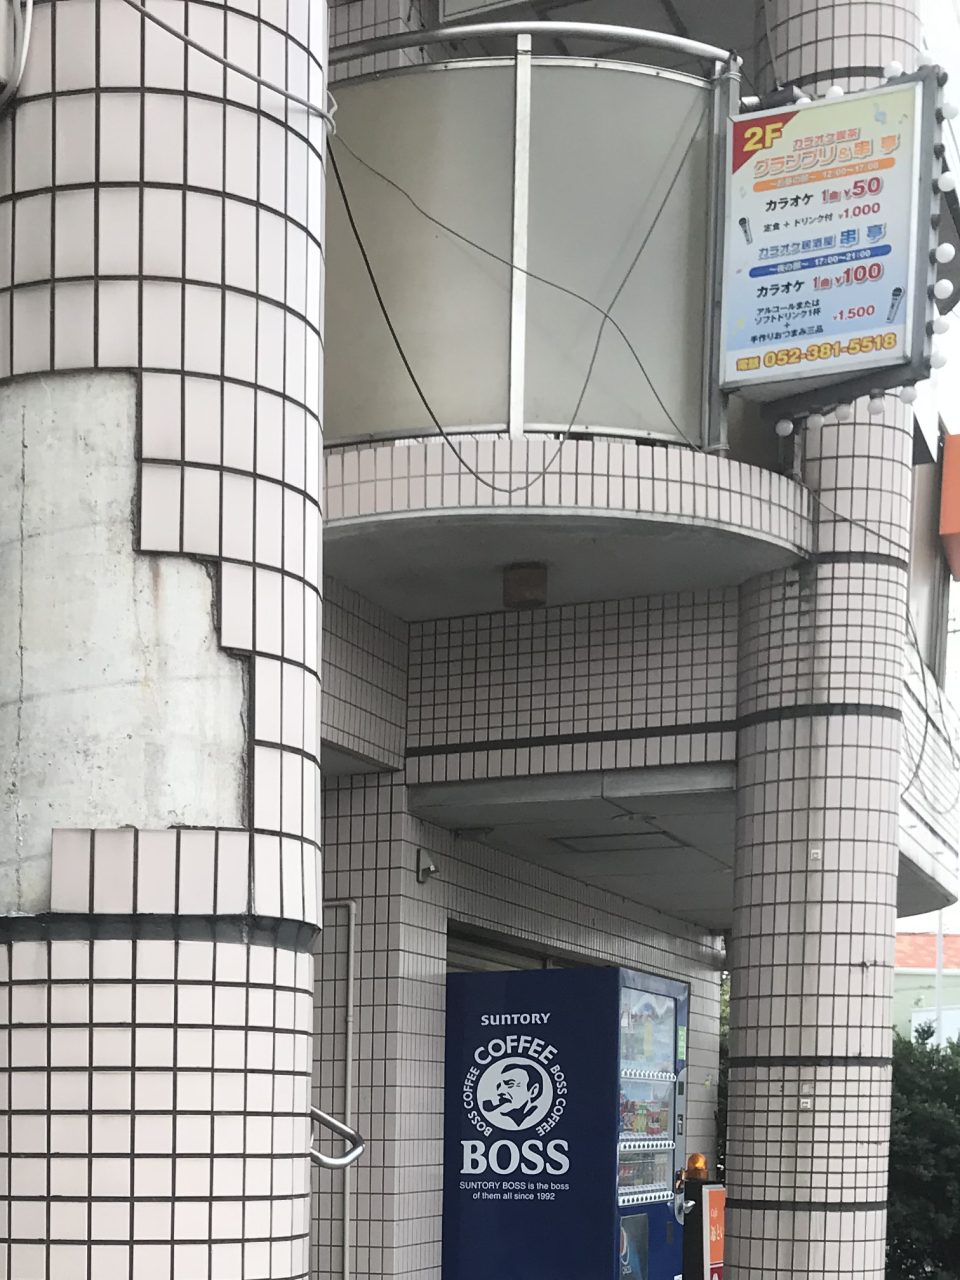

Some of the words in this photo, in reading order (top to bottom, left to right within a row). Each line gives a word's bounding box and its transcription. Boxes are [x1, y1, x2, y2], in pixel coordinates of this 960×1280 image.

[743, 122, 784, 152] 2F
[765, 193, 814, 212] カラオケ
[756, 280, 805, 298] カラオケ
[754, 308, 822, 325] ソフトドリンク1杯
[756, 299, 820, 315] アルコールまたは
[750, 325, 824, 344] 手作りおつまみ三品
[763, 333, 897, 368] 052-381-5518
[481, 1013, 551, 1026] SUNTORY
[474, 1035, 558, 1065] COFFEE
[463, 1066, 481, 1109] COFFEE
[550, 1064, 568, 1095] BOSS
[467, 1110, 493, 1137] BOSS
[535, 1098, 567, 1137] COFFEE
[460, 1139, 570, 1175] BOSS
[459, 1181, 501, 1190] SUNTORY
[502, 1181, 526, 1190] BOSS
[528, 1181, 535, 1190] is
[536, 1182, 549, 1190] the
[550, 1182, 570, 1190] boss
[472, 1191, 481, 1200] of
[482, 1191, 501, 1200] them
[502, 1191, 513, 1200] all
[514, 1191, 535, 1200] since
[537, 1192, 556, 1200] 1992
